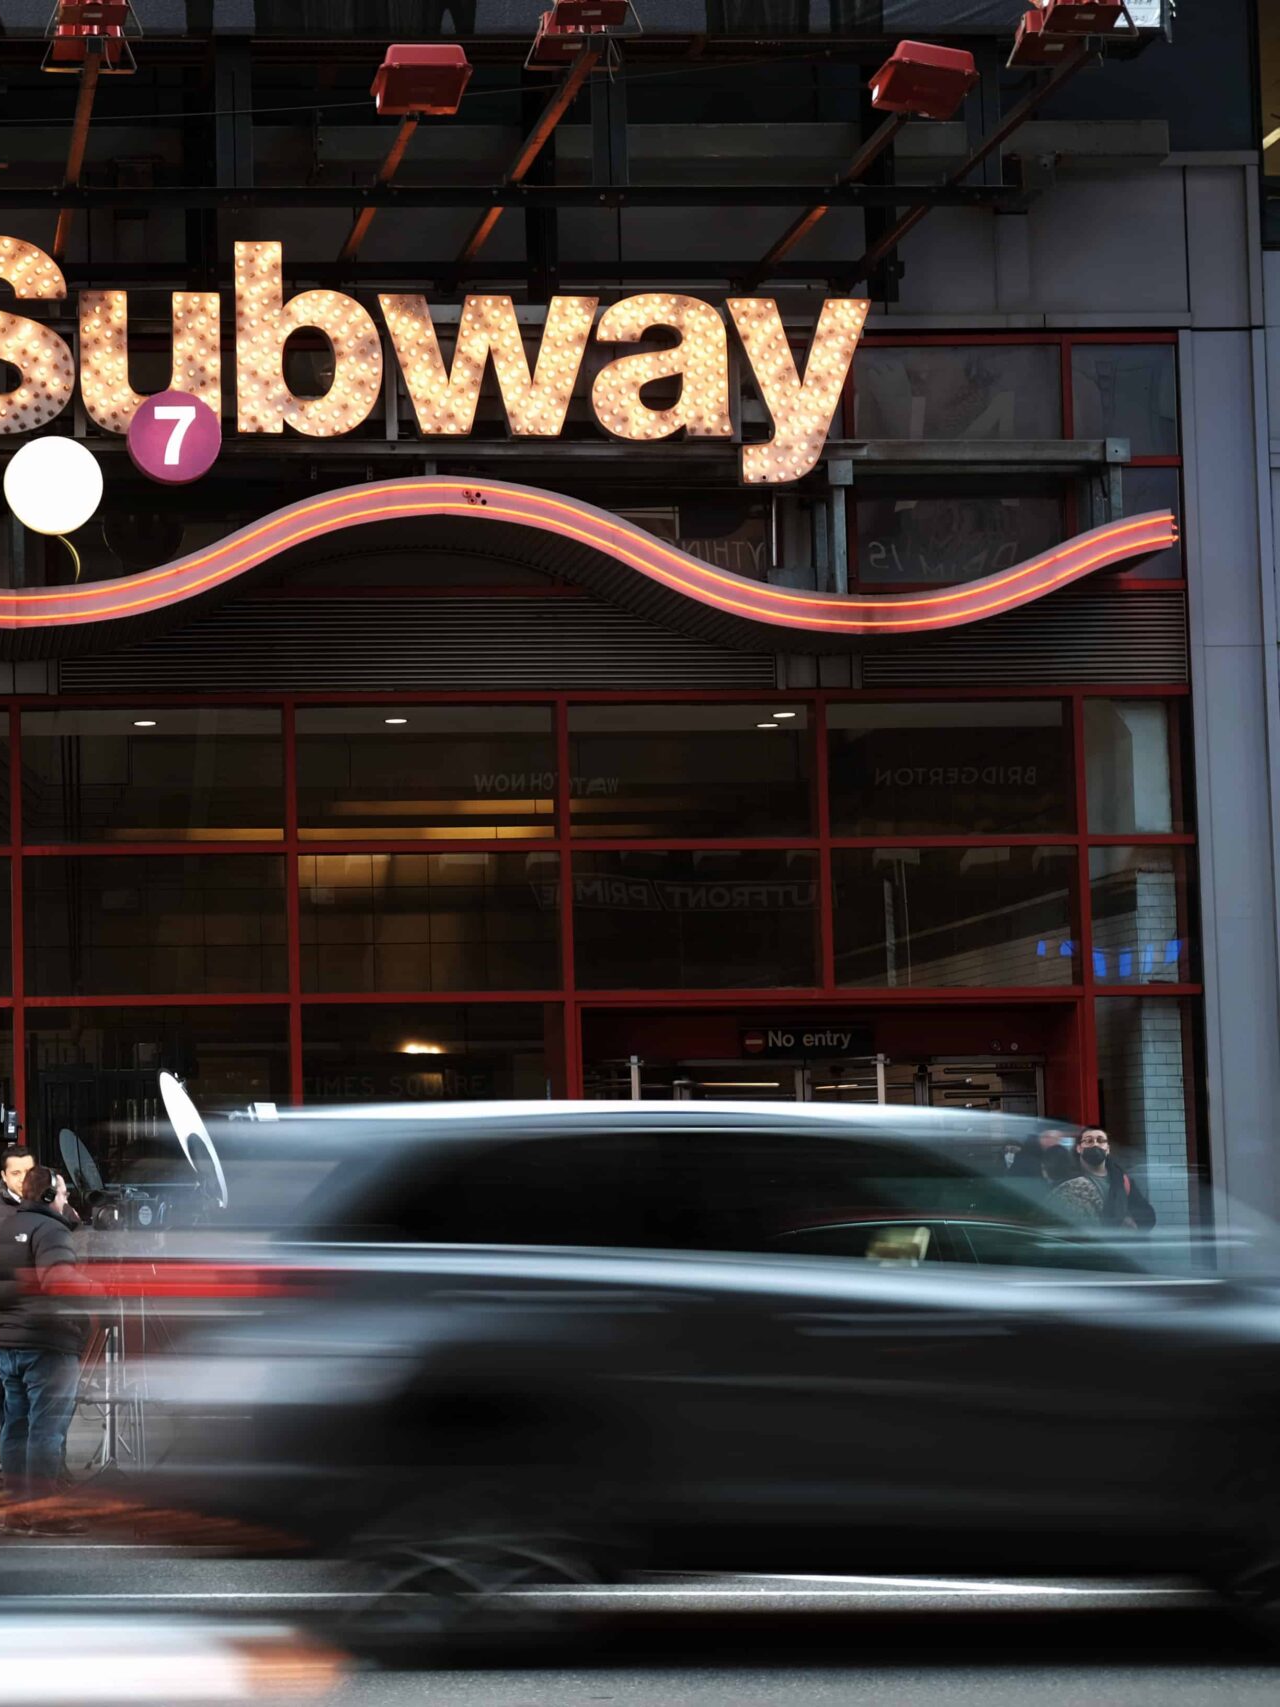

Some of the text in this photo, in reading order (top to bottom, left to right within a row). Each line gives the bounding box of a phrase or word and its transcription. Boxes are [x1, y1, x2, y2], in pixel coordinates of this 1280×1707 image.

[153, 405, 196, 465] 7
[768, 1030, 852, 1050] No entry
